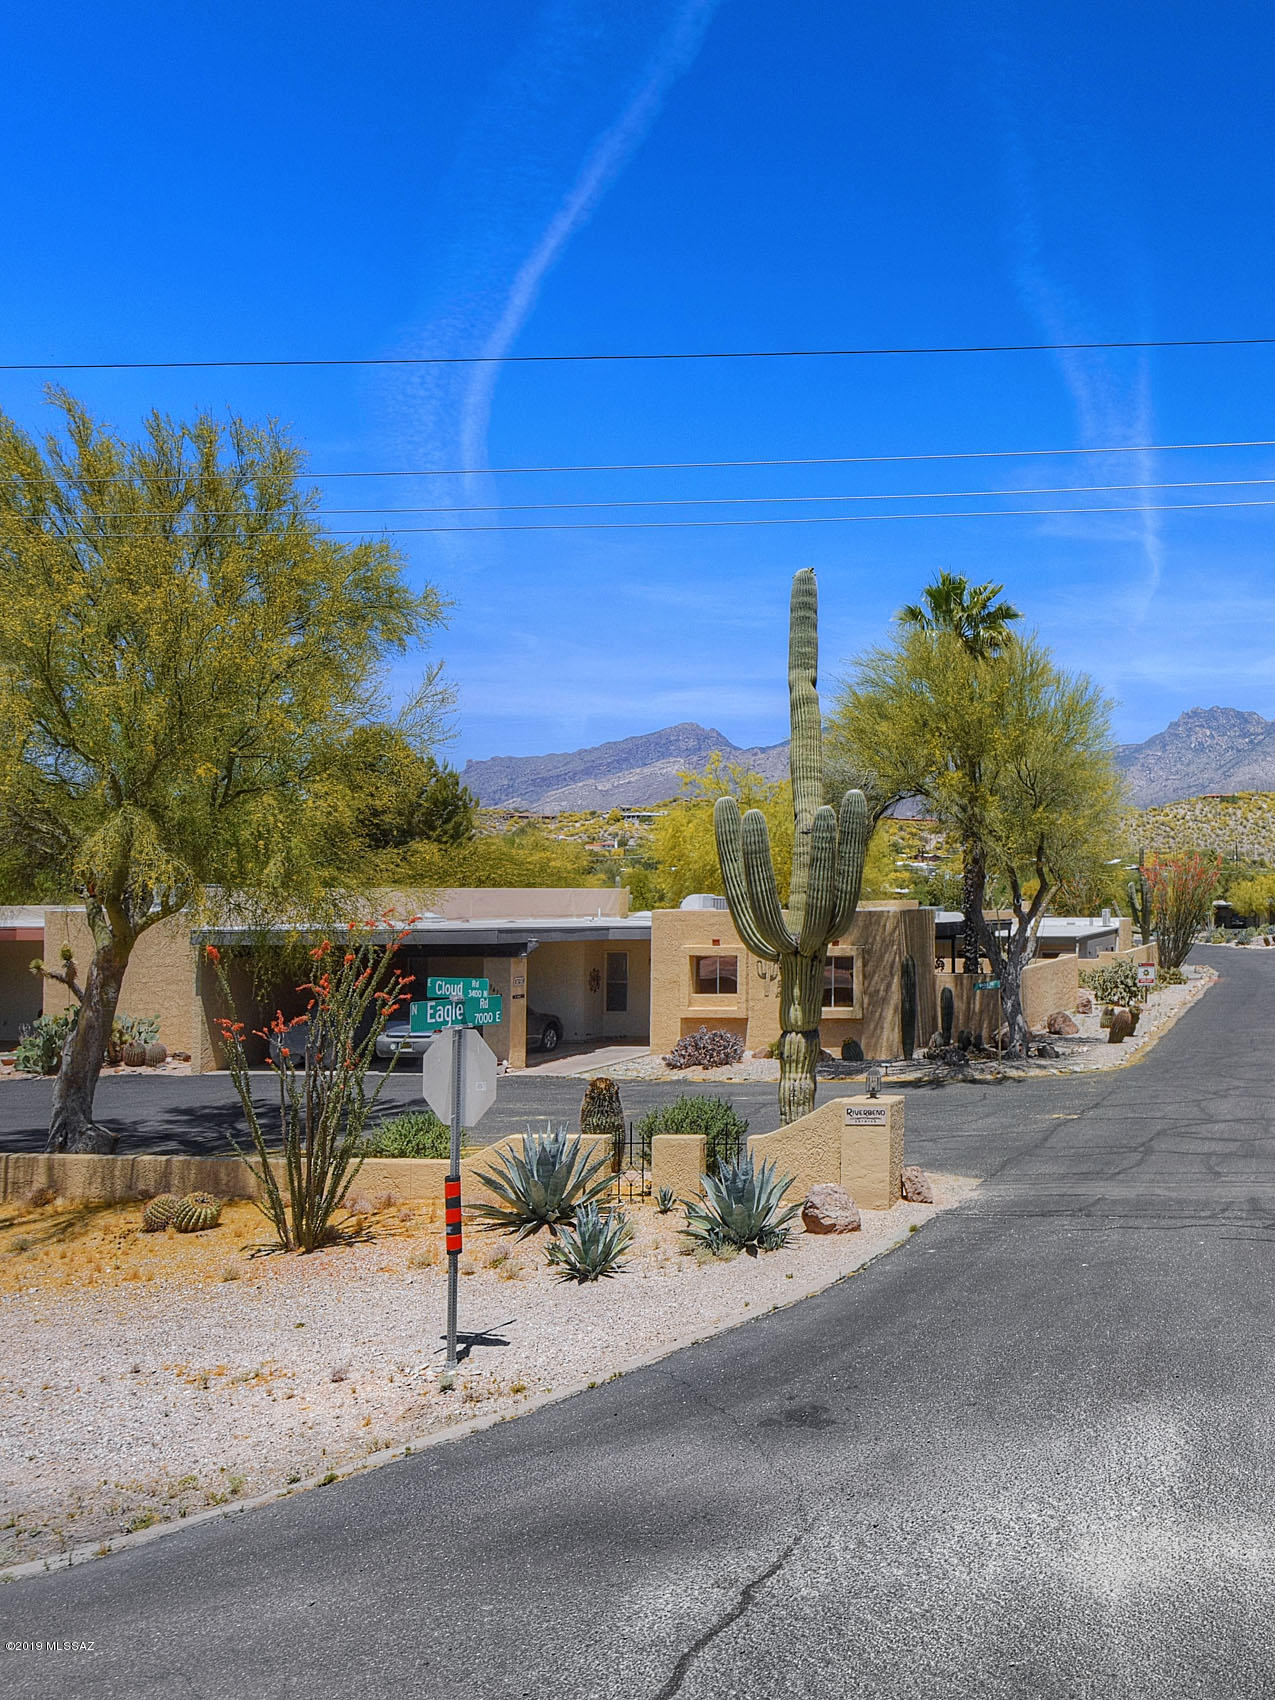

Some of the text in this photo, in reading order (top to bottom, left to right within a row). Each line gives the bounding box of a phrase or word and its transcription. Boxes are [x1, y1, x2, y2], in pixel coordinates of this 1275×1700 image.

[435, 981, 463, 995] Cloud
[472, 980, 479, 988] Rd
[468, 989, 482, 997] 3400
[411, 998, 489, 1026] N Eagle Rd
[474, 1011, 501, 1023] 7000 E
